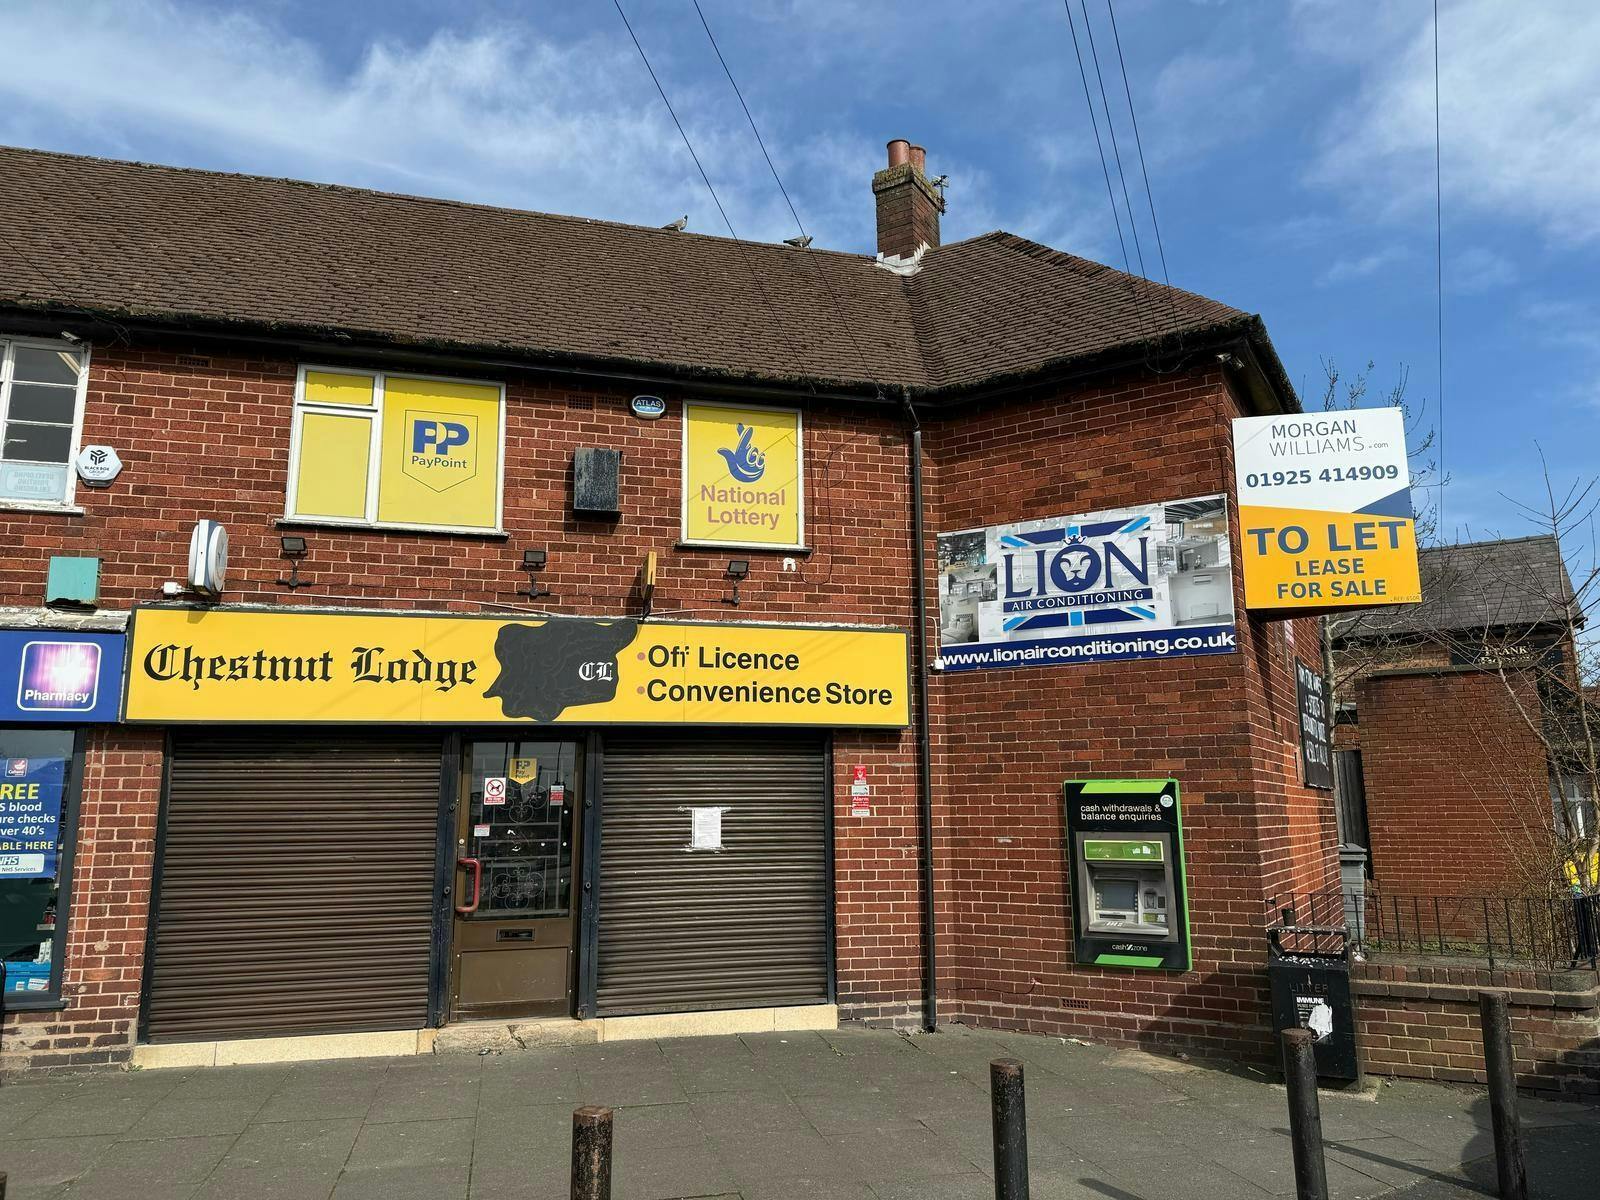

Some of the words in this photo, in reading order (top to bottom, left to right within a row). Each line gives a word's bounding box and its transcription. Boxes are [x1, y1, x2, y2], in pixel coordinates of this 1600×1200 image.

[636, 399, 662, 408] ATLAS
[1272, 420, 1357, 439] MORGAN
[1270, 436, 1365, 457] WILLIAMS
[411, 455, 467, 468] PayPoint
[1246, 470, 1312, 488] 01925
[1318, 464, 1399, 483] 414909
[701, 485, 785, 506] National
[707, 506, 780, 530] Lottery
[1247, 525, 1309, 556] TO
[1327, 521, 1406, 552] LET
[1003, 536, 1150, 598] LION
[1295, 558, 1365, 577] LEASE
[1277, 582, 1323, 599] FOR
[1331, 579, 1387, 597] SALE
[1012, 600, 1033, 611] AIR
[1037, 589, 1144, 608] CONDITIONING
[698, 646, 799, 670] Licence
[942, 632, 1236, 665] www.lionairconditioning.co.uk
[143, 643, 333, 690] Chestnut
[351, 647, 477, 692] Lodge
[578, 661, 613, 681] CL
[24, 689, 89, 703] Pharmacy
[646, 679, 821, 703] Convenience
[825, 683, 893, 705] Store
[0, 783, 40, 800] REE
[9, 802, 42, 812] blood
[1080, 804, 1100, 812] cash
[1102, 804, 1152, 812] withdrawals
[1154, 804, 1161, 812] &
[1081, 812, 1116, 821] balance
[1119, 812, 1162, 822] enquiries
[18, 814, 56, 823] checks
[22, 826, 45, 835] 40's
[25, 842, 54, 850] HERE
